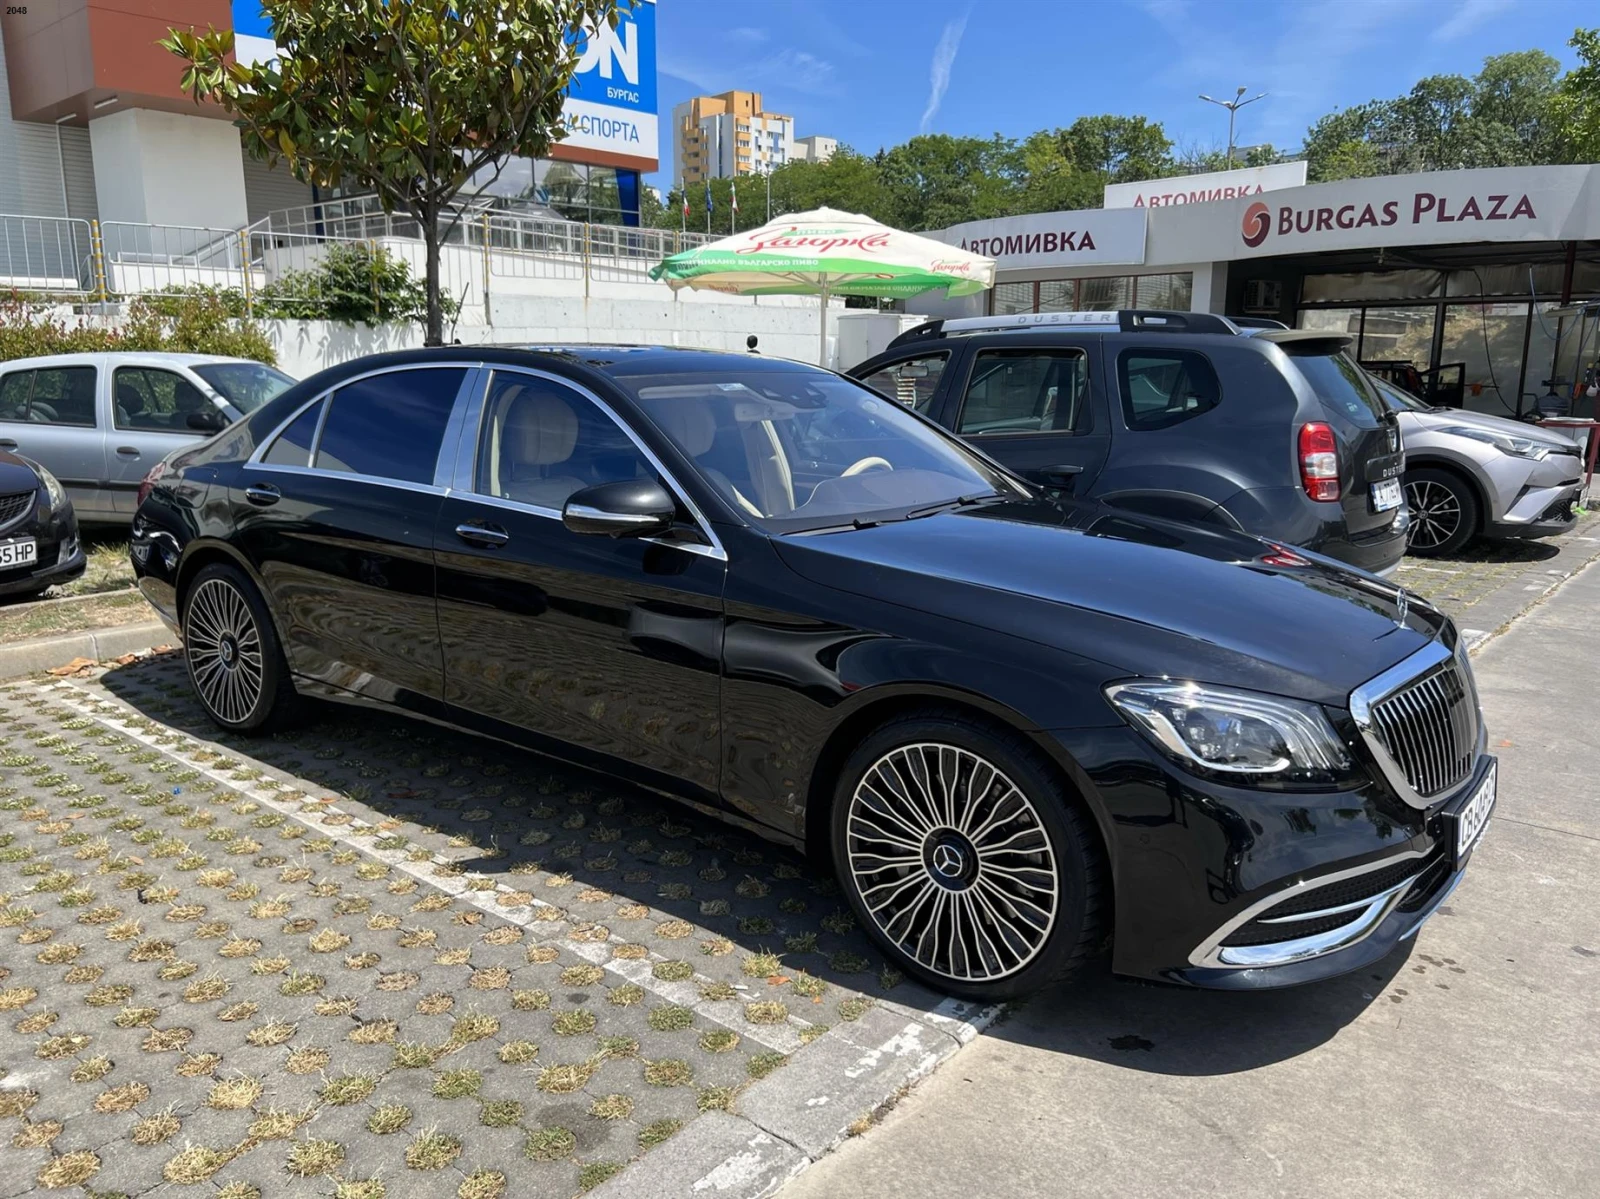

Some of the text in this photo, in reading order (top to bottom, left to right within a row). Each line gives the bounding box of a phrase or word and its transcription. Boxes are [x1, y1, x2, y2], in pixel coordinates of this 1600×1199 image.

[607, 86, 639, 103] БУРГАС
[580, 115, 640, 143] СПОРТА
[1278, 192, 1537, 236] BURGAS PLAZA
[1017, 313, 1111, 324] DUSTER
[15, 543, 34, 562] HP
